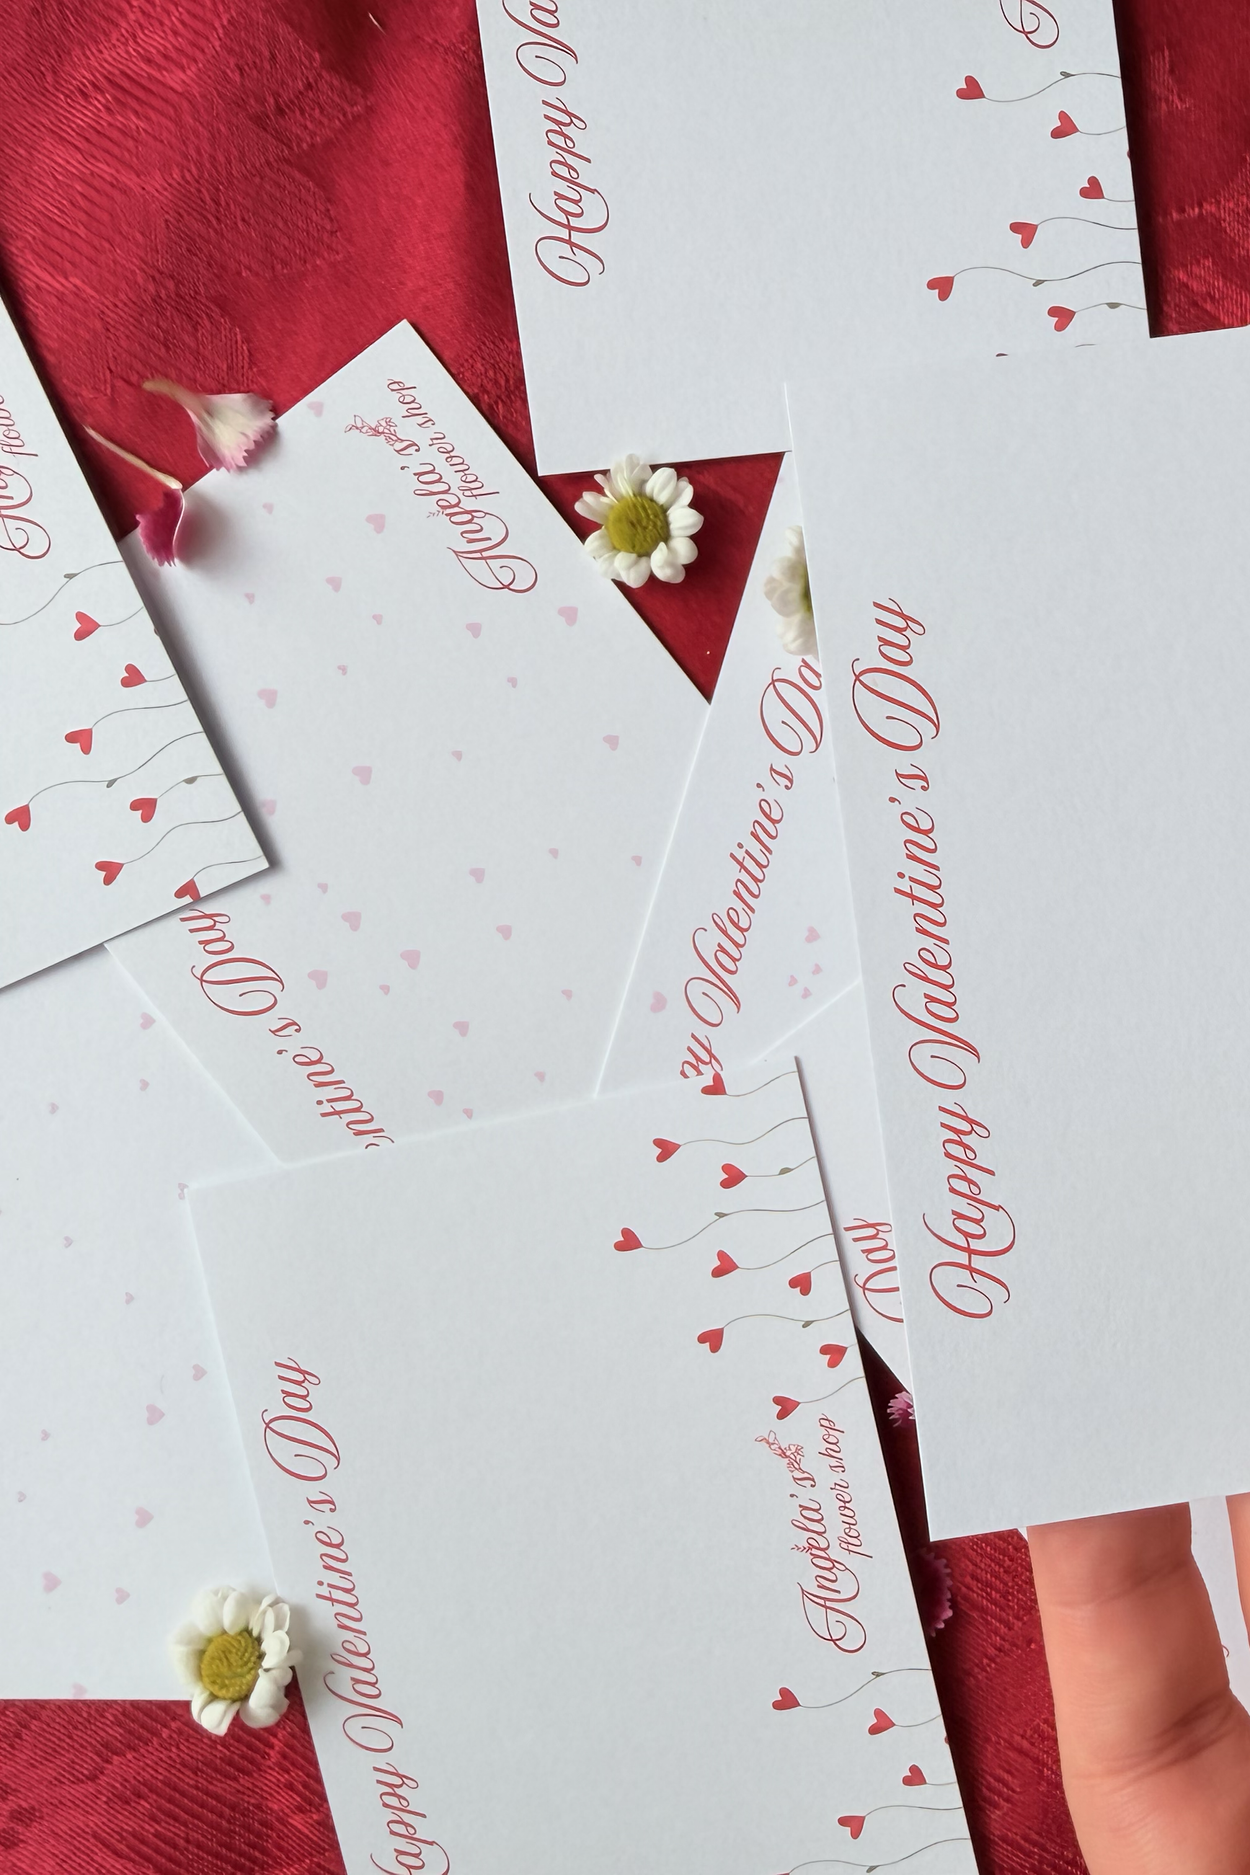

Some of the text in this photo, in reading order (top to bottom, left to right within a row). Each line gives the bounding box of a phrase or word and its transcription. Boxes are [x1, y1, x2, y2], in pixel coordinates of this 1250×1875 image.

[529, 96, 610, 287] Happy
[386, 378, 500, 500] flower shop
[392, 438, 538, 593] Angela's
[684, 763, 795, 1028] Valentine's
[759, 657, 824, 757] Da
[179, 908, 285, 1017] Day
[852, 597, 1016, 1319] Happy Valentine's Day
[261, 1356, 341, 1482] Day
[818, 1413, 874, 1559] flower shop
[303, 1490, 404, 1754] Valentine's
[789, 1470, 867, 1655] Angela's
